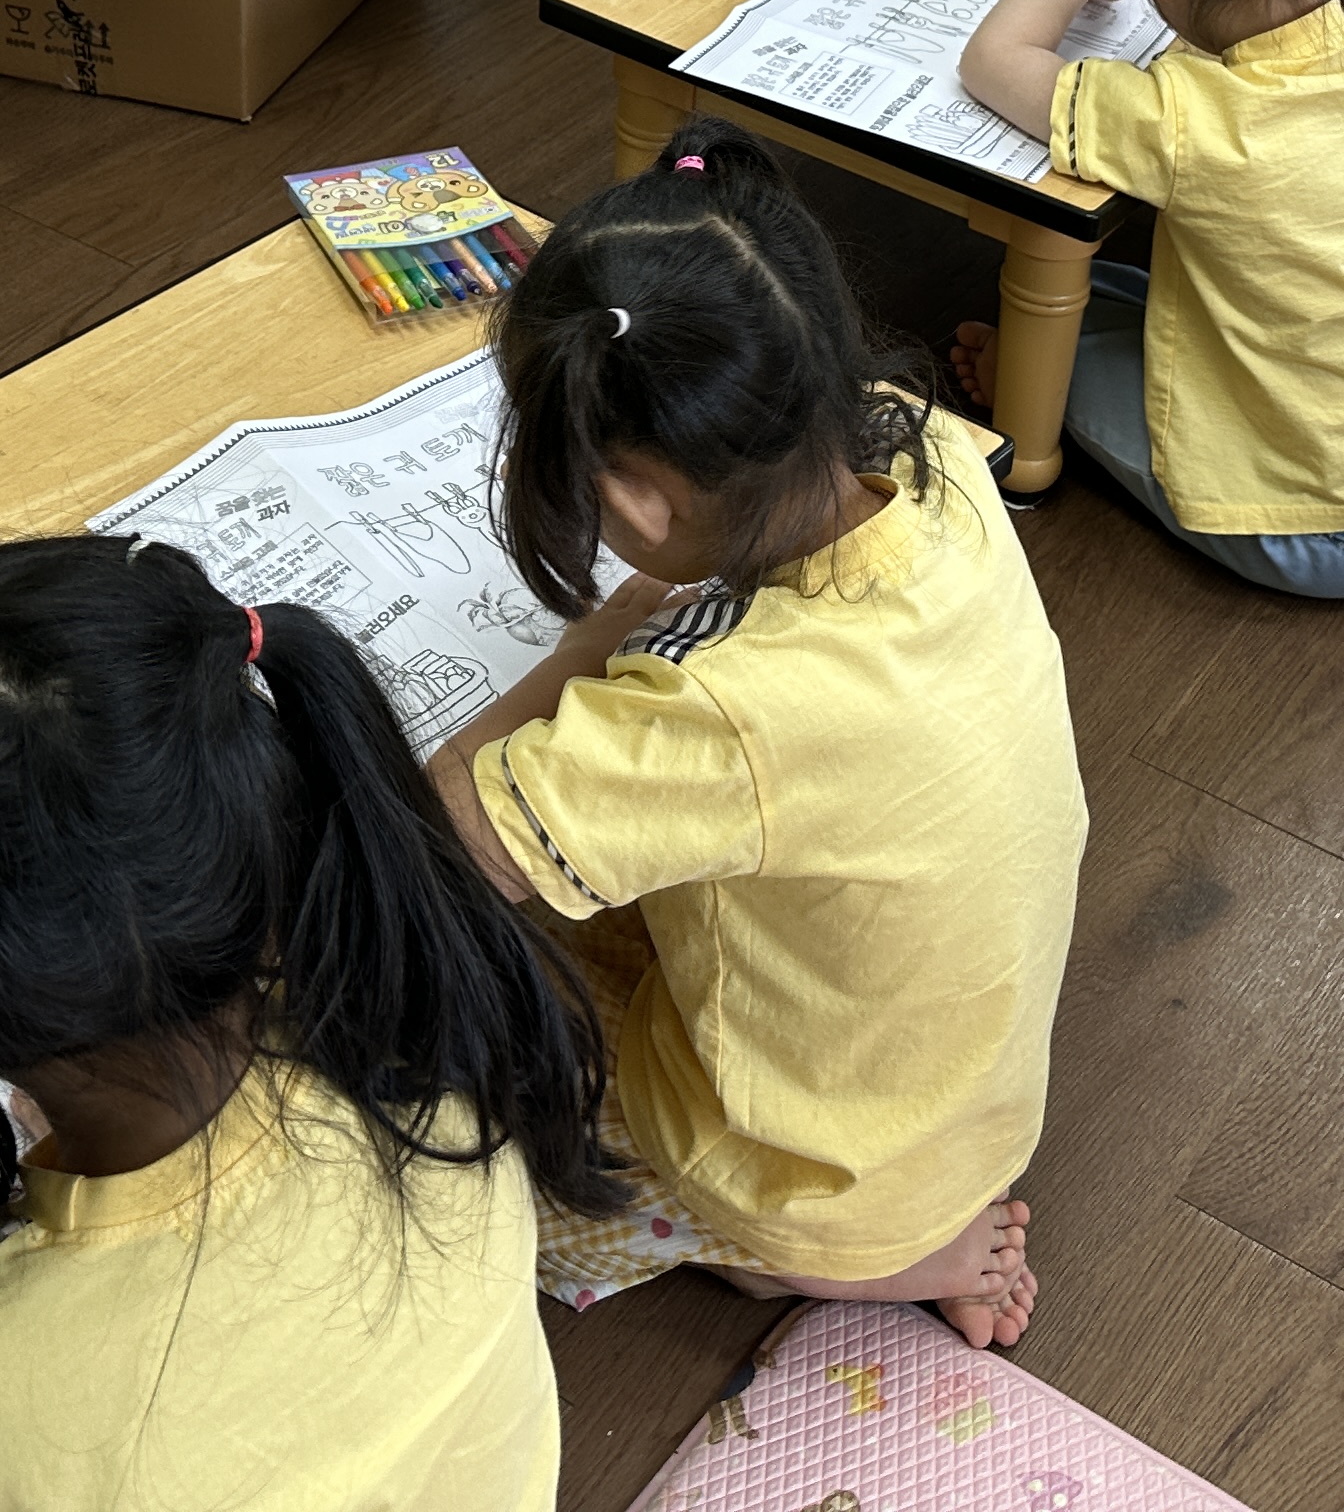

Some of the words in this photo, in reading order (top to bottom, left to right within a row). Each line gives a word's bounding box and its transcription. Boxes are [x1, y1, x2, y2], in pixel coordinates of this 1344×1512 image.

[424, 150, 460, 169] 12
[383, 449, 428, 475] 귀
[421, 423, 488, 464] 토끼
[256, 501, 291, 524] 과자
[216, 516, 262, 553] 토끼
